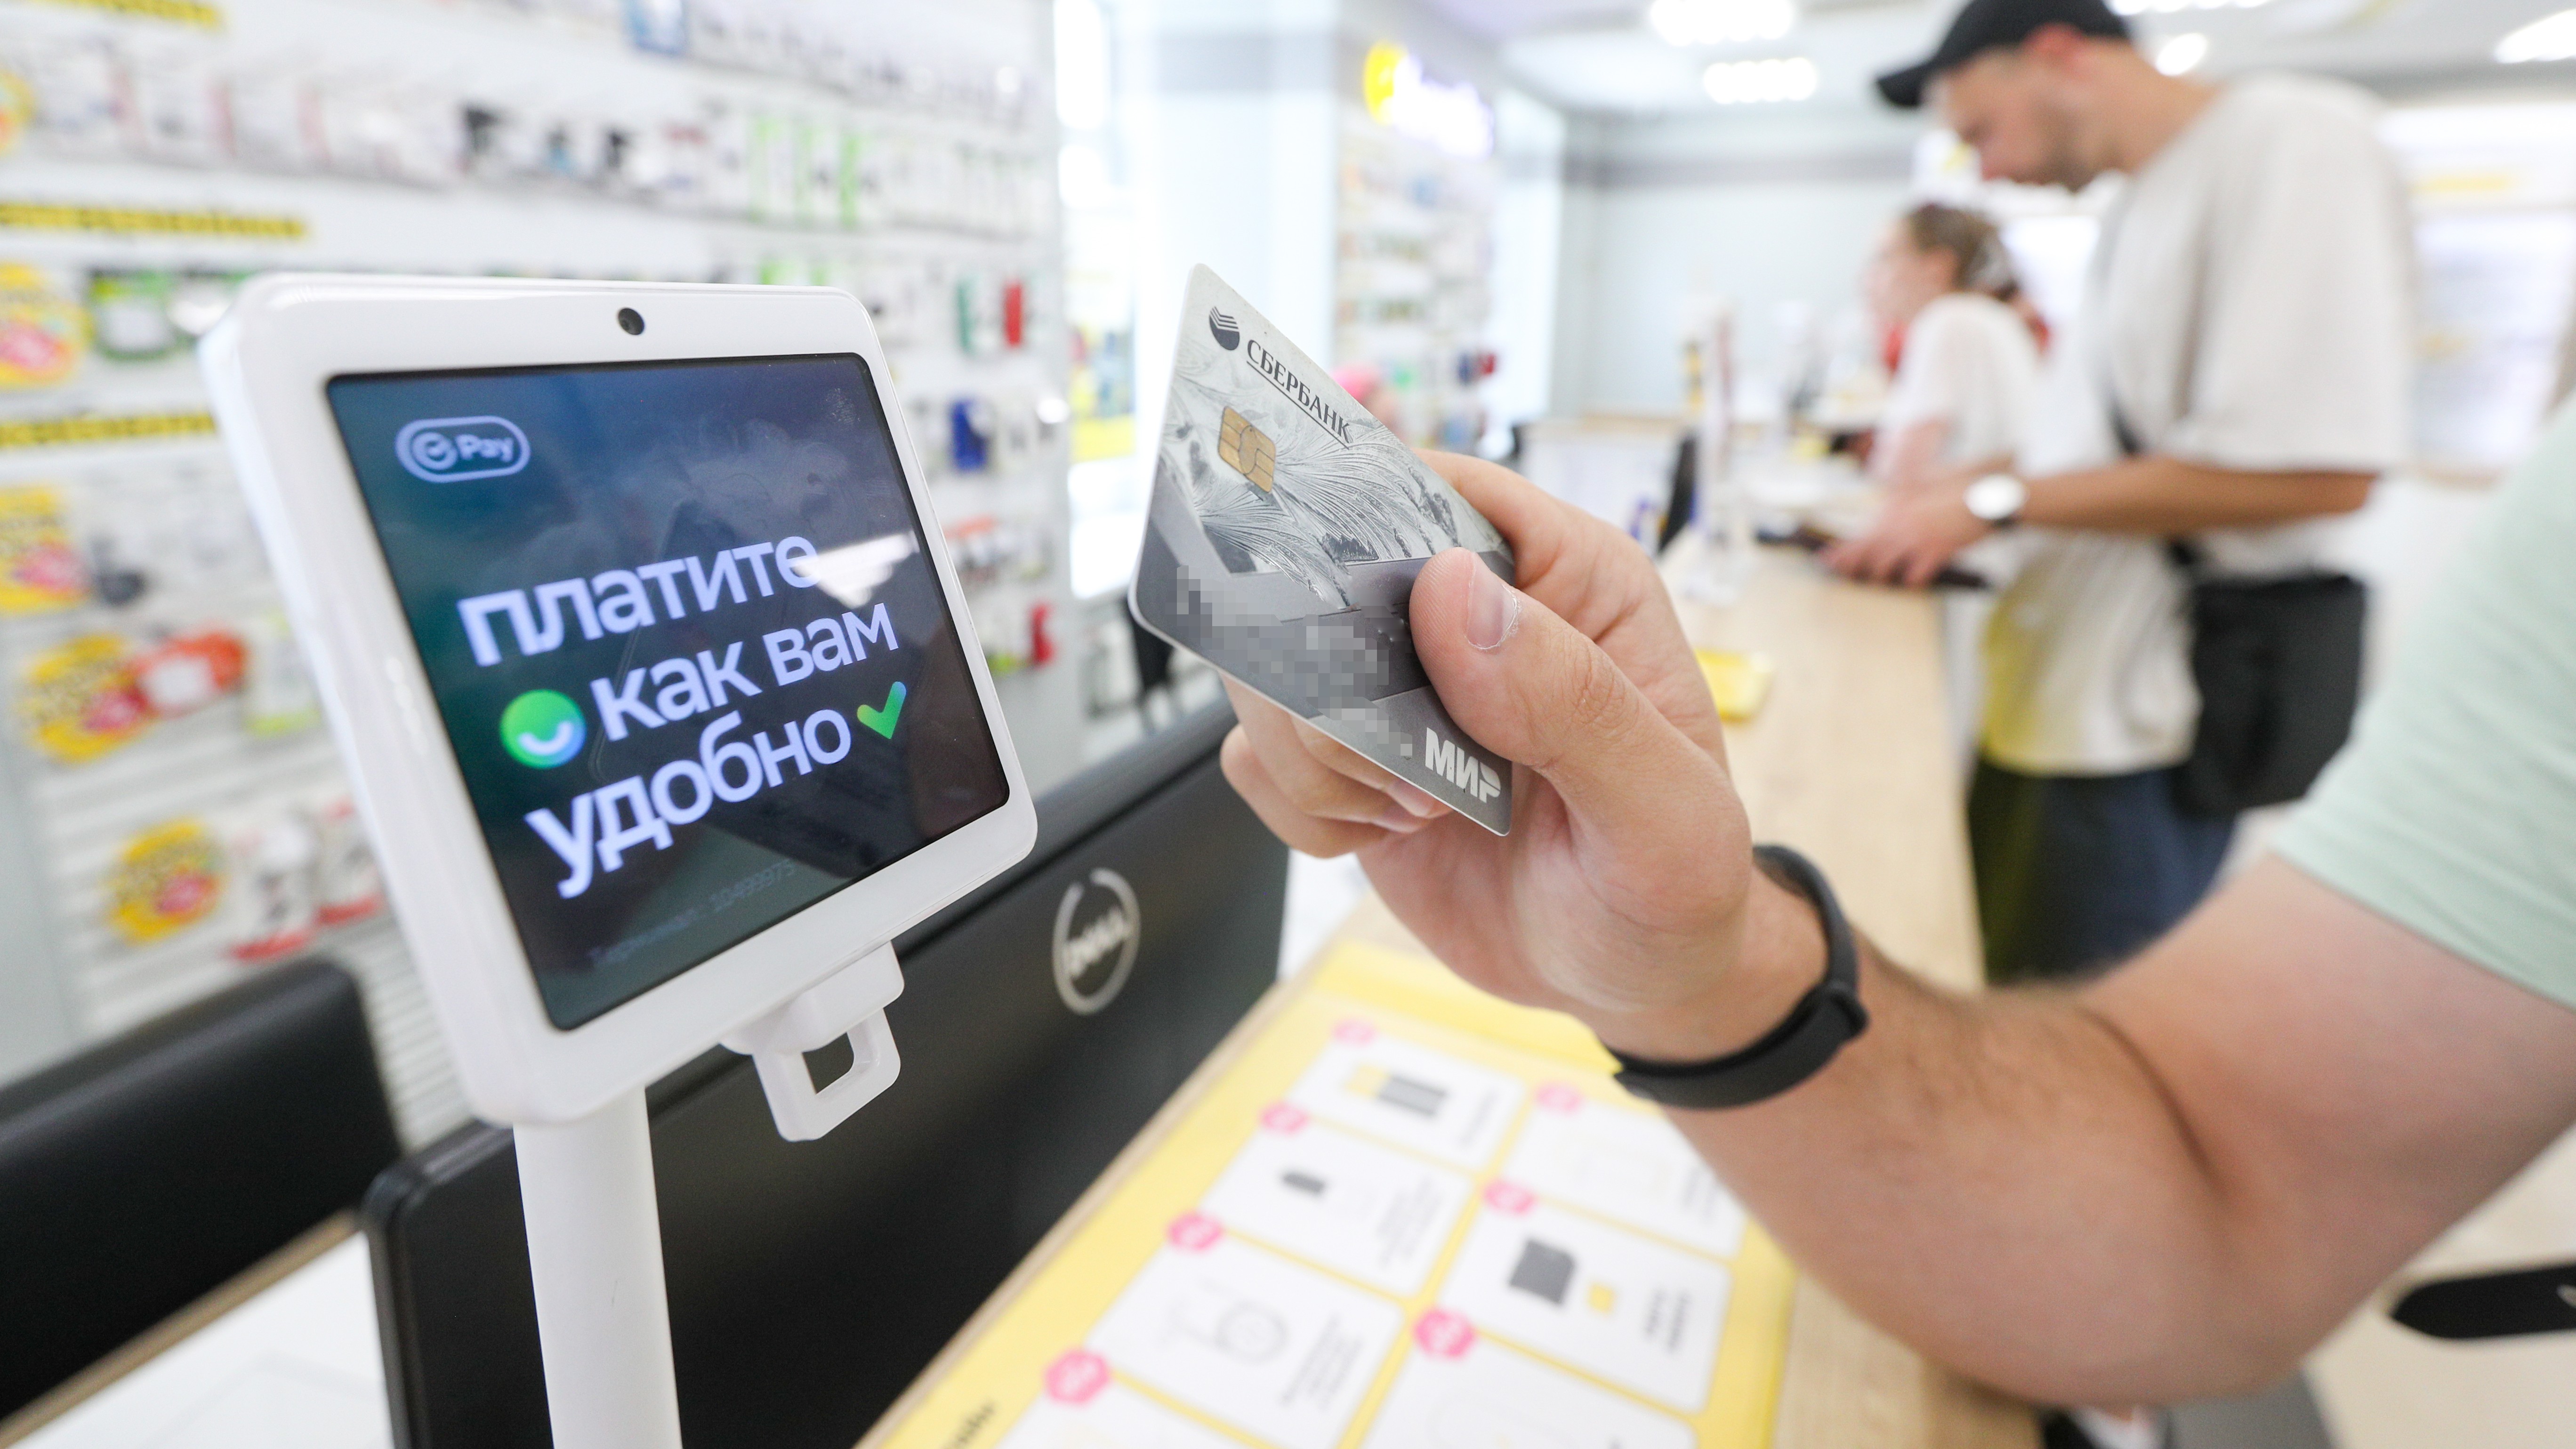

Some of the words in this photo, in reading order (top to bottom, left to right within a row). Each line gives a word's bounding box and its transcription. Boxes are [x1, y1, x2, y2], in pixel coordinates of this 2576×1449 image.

[455, 434, 514, 463] Pay
[1247, 339, 1350, 444] СБЕРБАНК
[455, 535, 820, 668] платите
[589, 641, 763, 741] как
[762, 603, 899, 686] вам
[524, 709, 852, 899] удобно
[1425, 727, 1501, 803] МИР
